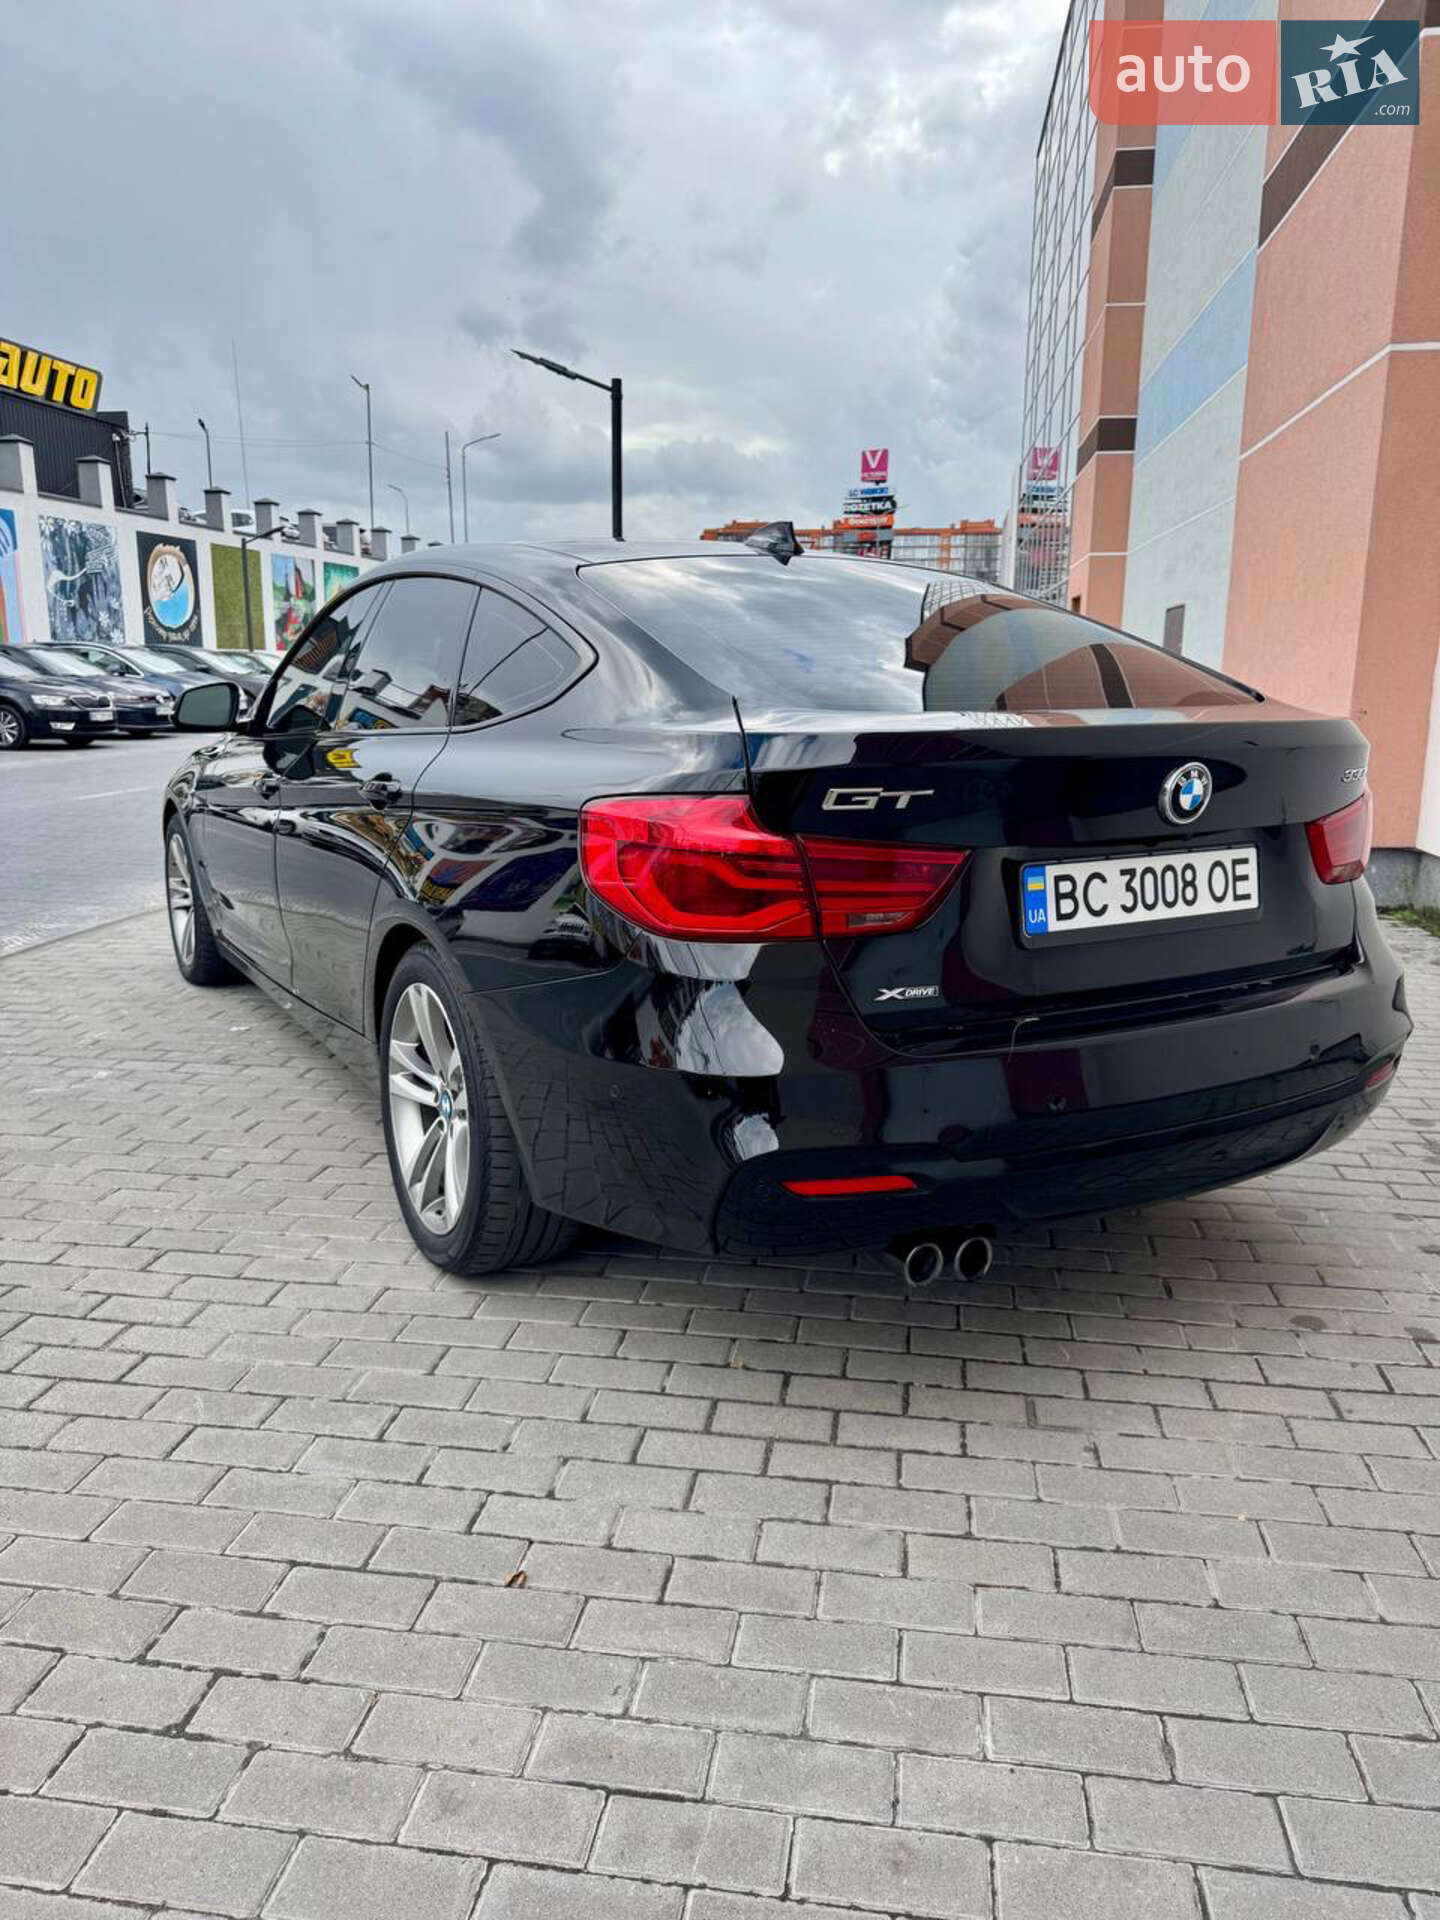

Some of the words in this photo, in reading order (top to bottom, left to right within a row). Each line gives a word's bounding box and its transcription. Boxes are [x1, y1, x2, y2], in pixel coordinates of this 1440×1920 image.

[0, 341, 97, 410] AUTO
[865, 450, 882, 469] V
[821, 787, 935, 810] GT
[1053, 871, 1109, 922] BC
[1119, 862, 1199, 914] 3008
[1207, 857, 1252, 903] OE
[1028, 908, 1047, 924] UA
